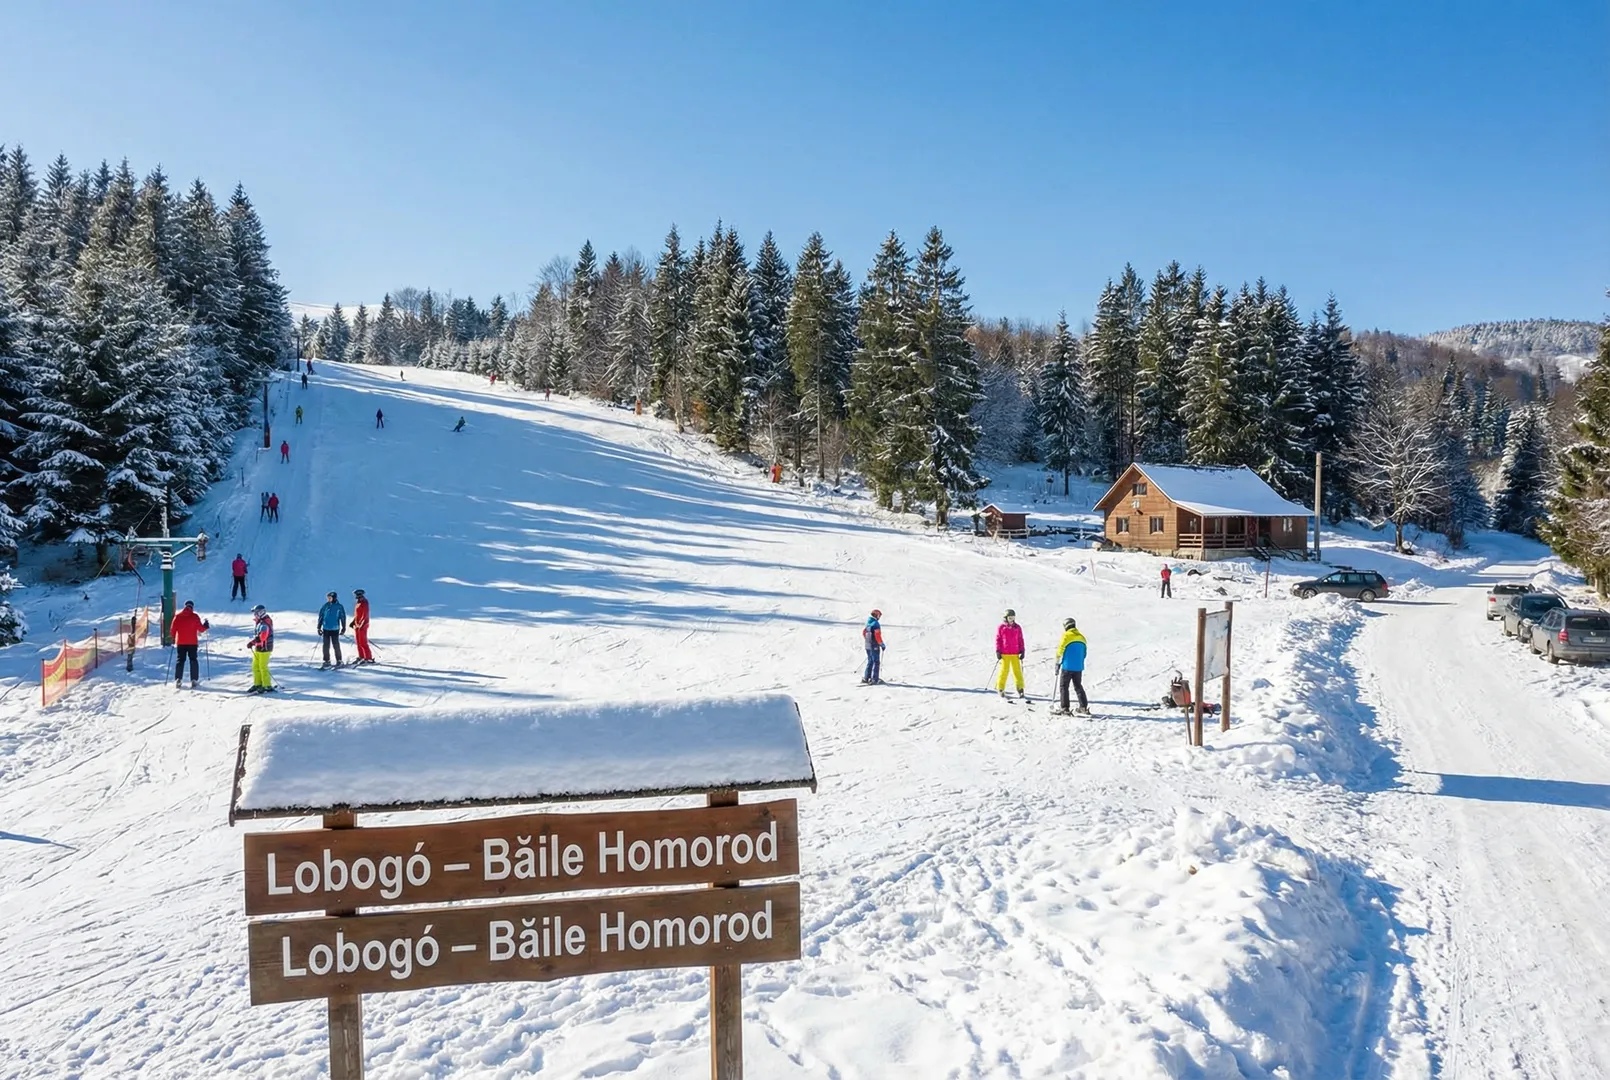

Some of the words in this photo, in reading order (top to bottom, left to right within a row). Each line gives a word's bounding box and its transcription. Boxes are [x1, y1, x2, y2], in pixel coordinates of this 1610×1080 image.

[267, 842, 431, 900] Lobogó
[483, 834, 584, 881] Băile
[598, 821, 778, 873] Homorod
[282, 925, 440, 980] Lobogó
[489, 916, 586, 962] Băile
[600, 900, 773, 953] Homorod
